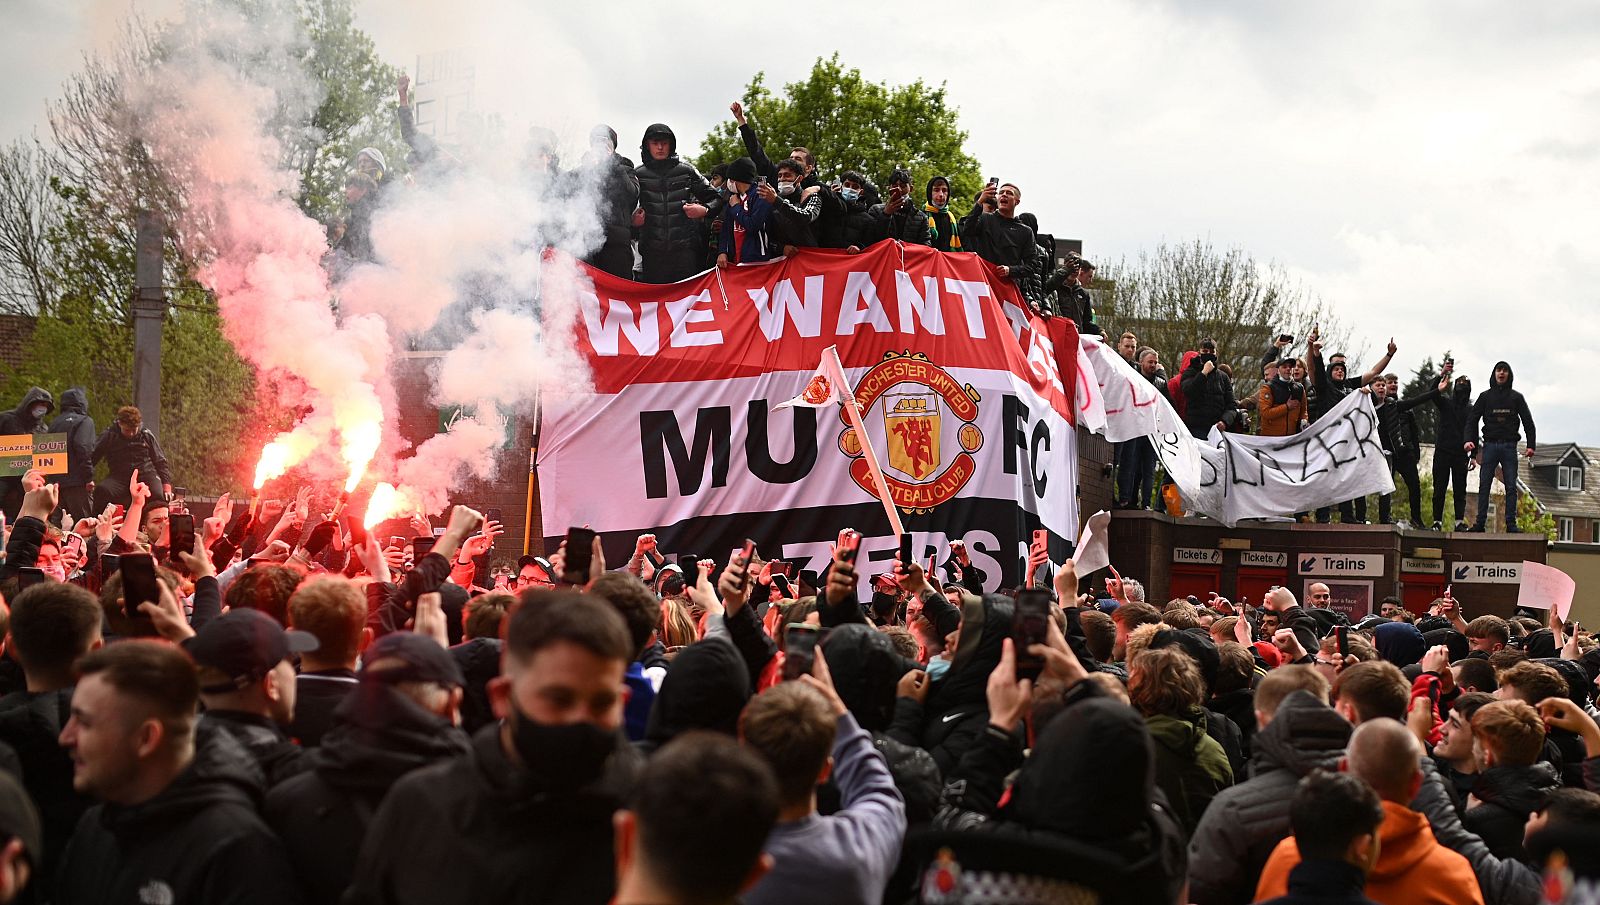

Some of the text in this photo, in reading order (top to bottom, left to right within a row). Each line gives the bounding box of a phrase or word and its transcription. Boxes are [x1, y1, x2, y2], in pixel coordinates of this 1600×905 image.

[578, 289, 723, 356] WE
[746, 270, 991, 343] WANT
[857, 363, 927, 408] ANCHESTER
[930, 370, 970, 414] UNITED
[38, 442, 66, 450] OUT
[38, 458, 54, 467] IN
[934, 466, 965, 498] CLUB
[1176, 550, 1208, 560] Tickets
[1243, 553, 1273, 563] Tickets
[1322, 557, 1366, 570] Trains
[1475, 565, 1517, 578] Trains
